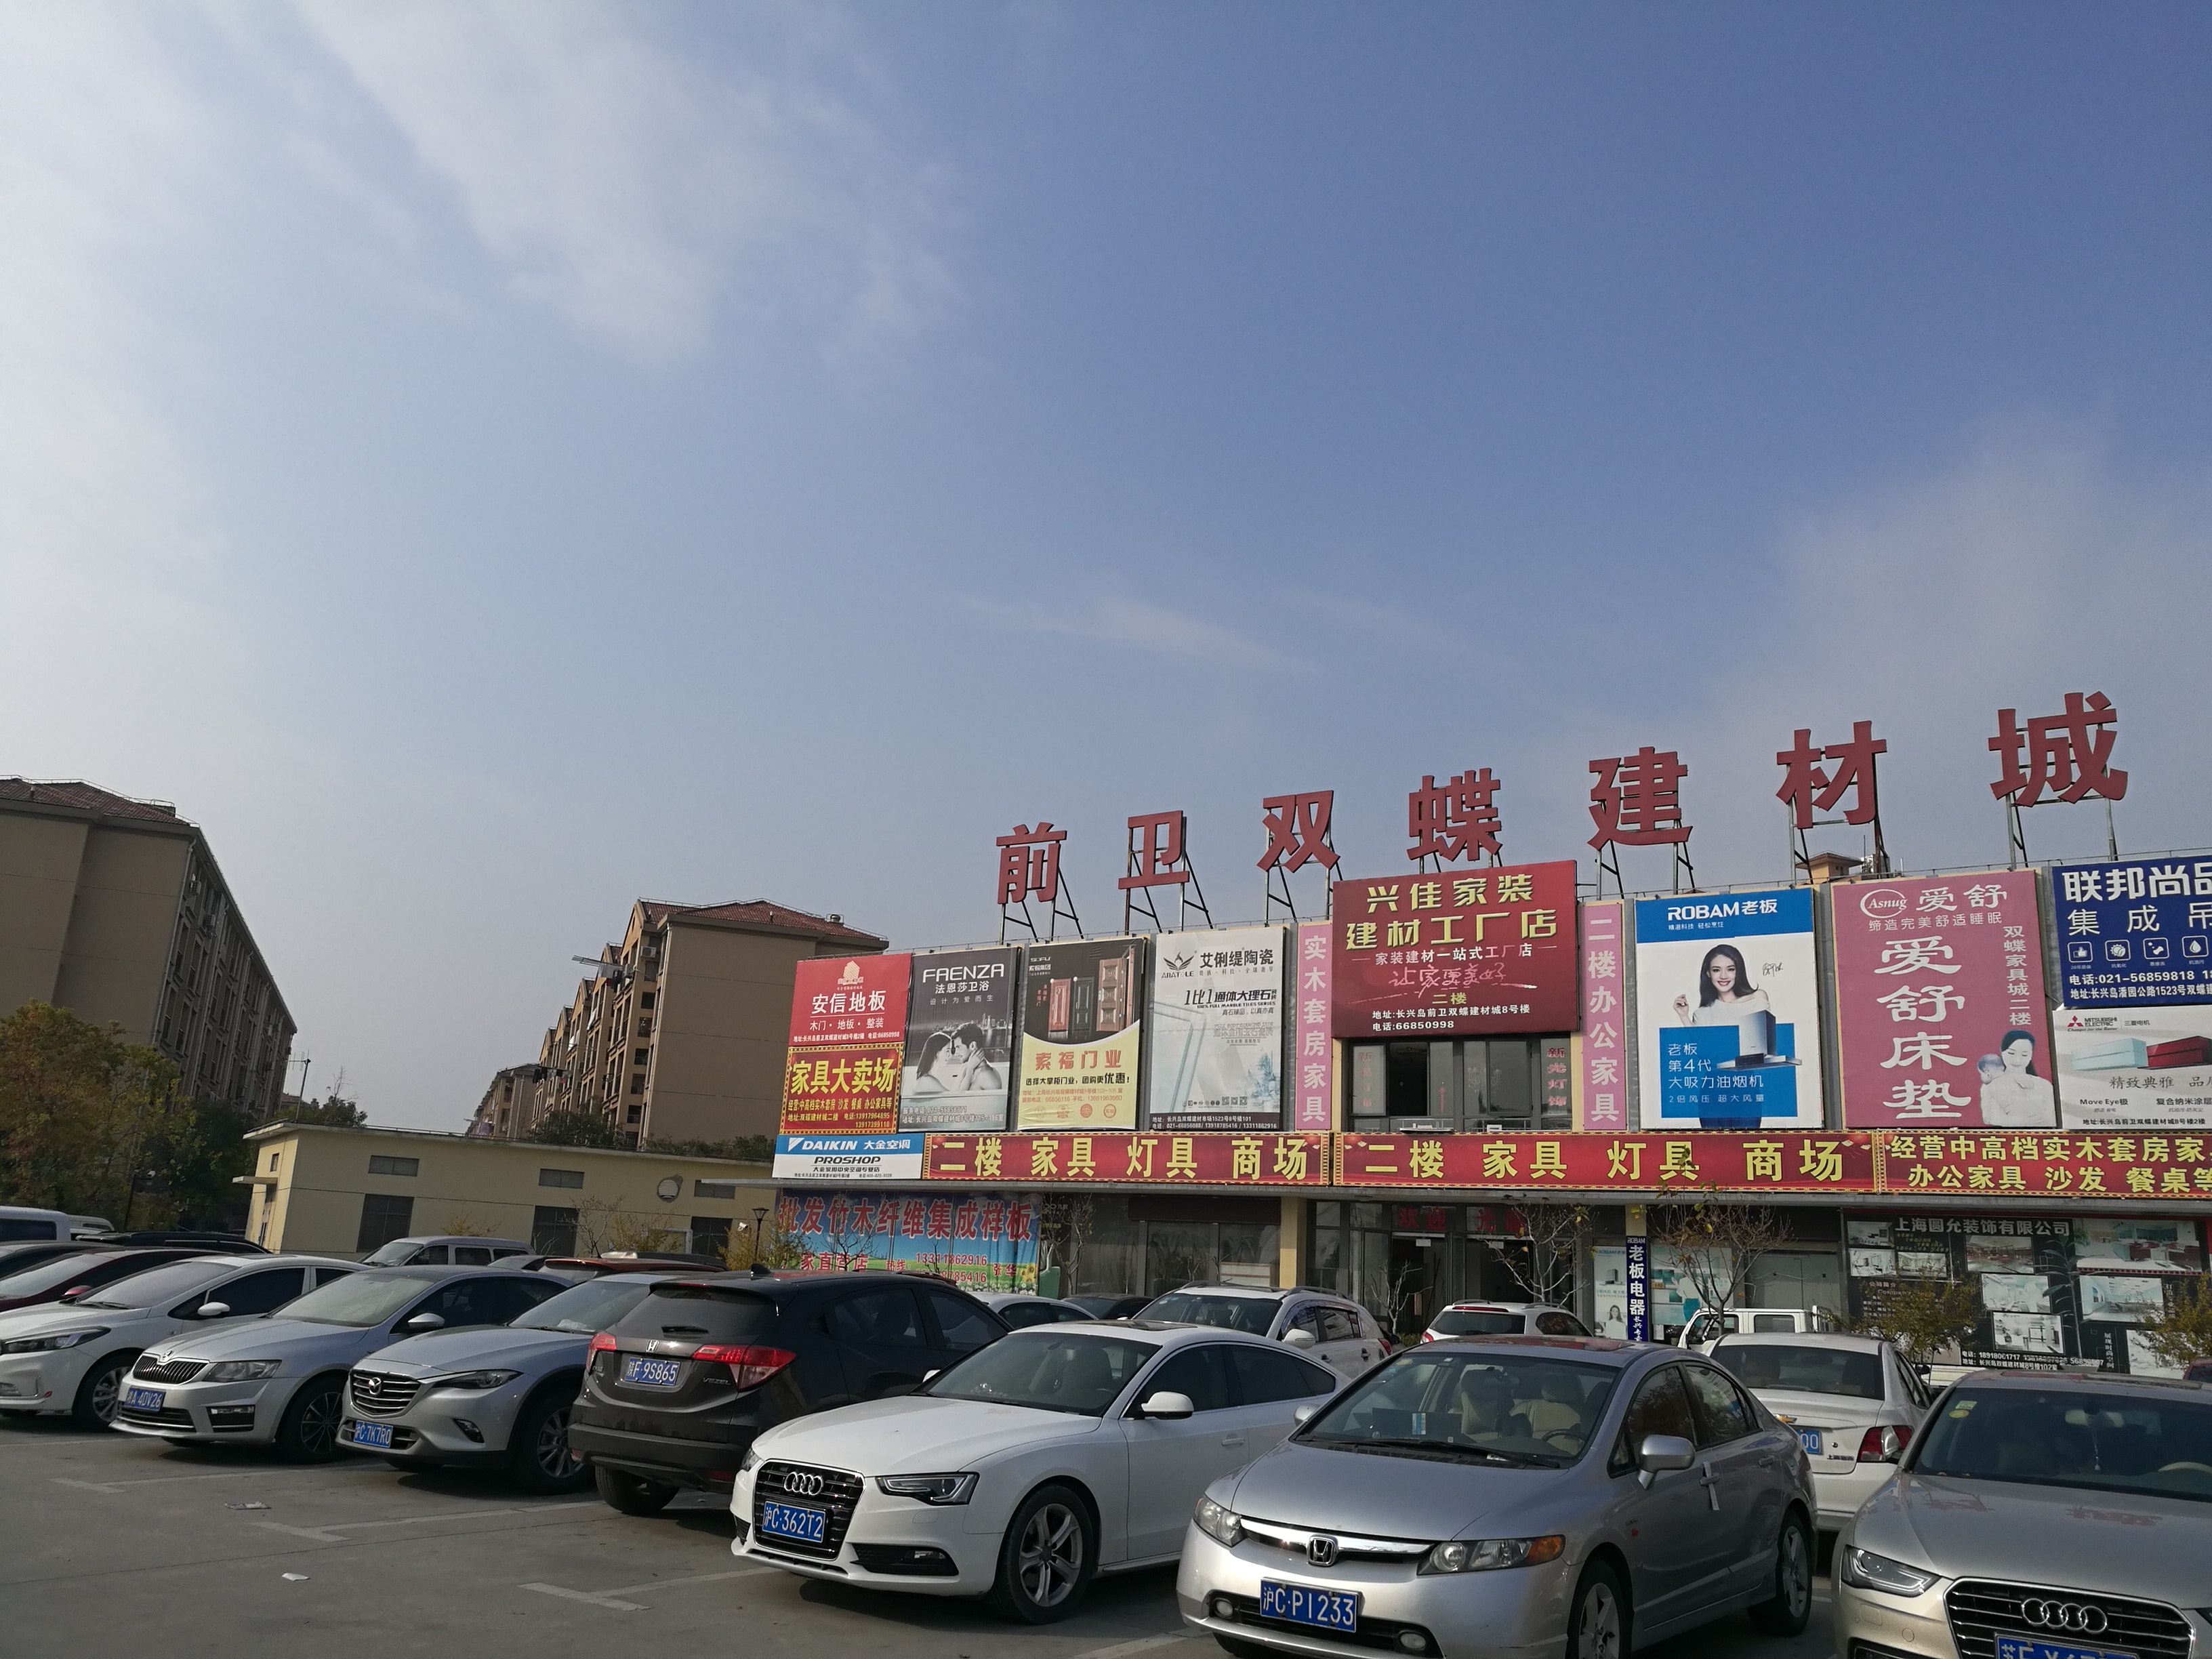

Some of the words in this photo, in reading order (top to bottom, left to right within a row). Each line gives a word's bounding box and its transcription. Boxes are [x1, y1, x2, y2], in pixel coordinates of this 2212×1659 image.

[996, 691, 2128, 904] 前卫双蝶建材城
[1368, 874, 1533, 913] 兴佳家装
[1868, 898, 1908, 909] Asnug
[1916, 884, 2007, 912] 爱舒
[1346, 909, 1557, 950] 建材工厂店
[1868, 912, 2002, 932] 缔造完美舒适睡眠
[1200, 949, 1274, 968] 艾俐缇陶瓷
[1375, 943, 1532, 966] 家装建材一站式工厂店
[922, 963, 1004, 983] FAENZA
[1389, 962, 1507, 994] 让家更美好
[2003, 926, 2032, 1026] 双蝶家具城二楼
[2069, 971, 2195, 986] 电话:021-56859818
[935, 981, 989, 994] 法恩莎卫浴
[811, 990, 886, 1014] 安信地板
[930, 994, 994, 1005] 设计为爱而生
[1432, 992, 1467, 1004] 二楼
[1372, 1004, 1530, 1019] 地址:长兴岛前卫双蝶建材城8号楼
[1589, 918, 1619, 1122] 二楼办公家具
[1302, 935, 1326, 1122] 实木套房家具
[1373, 1021, 1454, 1031] 电话:66850998
[1874, 935, 1971, 1119] 爱舒床垫
[1668, 1043, 1698, 1056] 老板
[1036, 1050, 1122, 1071] 索福门业
[1668, 1059, 1711, 1072] 第4代
[790, 1057, 895, 1094] 家具大卖场
[1668, 1075, 1763, 1088] 大吸力油烟机
[2110, 1076, 2174, 1088] 精致典雅
[838, 1098, 849, 1110] 沙发
[864, 1097, 893, 1109] 办公家具等
[1669, 1094, 1710, 1103] 2倍风压
[1718, 1093, 1765, 1103] 超大风量
[802, 1141, 857, 1150] DAIKIN
[863, 1139, 911, 1150] 大金空调
[1891, 1136, 2212, 1162] 经营中高档实木套房家
[814, 1156, 881, 1164] PROSHOP
[940, 1138, 1002, 1177] 二楼
[1031, 1136, 1096, 1176] 家具
[1126, 1136, 1197, 1178] 灯具
[1231, 1137, 1308, 1180] 商场
[1366, 1141, 1444, 1179] 二楼
[1483, 1141, 1567, 1179] 家具
[1607, 1140, 1700, 1181] 灯具
[1743, 1139, 1843, 1182] 商场
[1908, 1164, 2026, 1189] 办公家具
[2044, 1165, 2107, 1191] 沙发
[777, 1197, 1033, 1242] 批发竹木纤维集成样板
[1895, 1217, 2070, 1236] 上海圆允装饰有限公司
[1629, 1245, 1645, 1315] 老板电器
[703, 1377, 731, 1385] VEZEL
